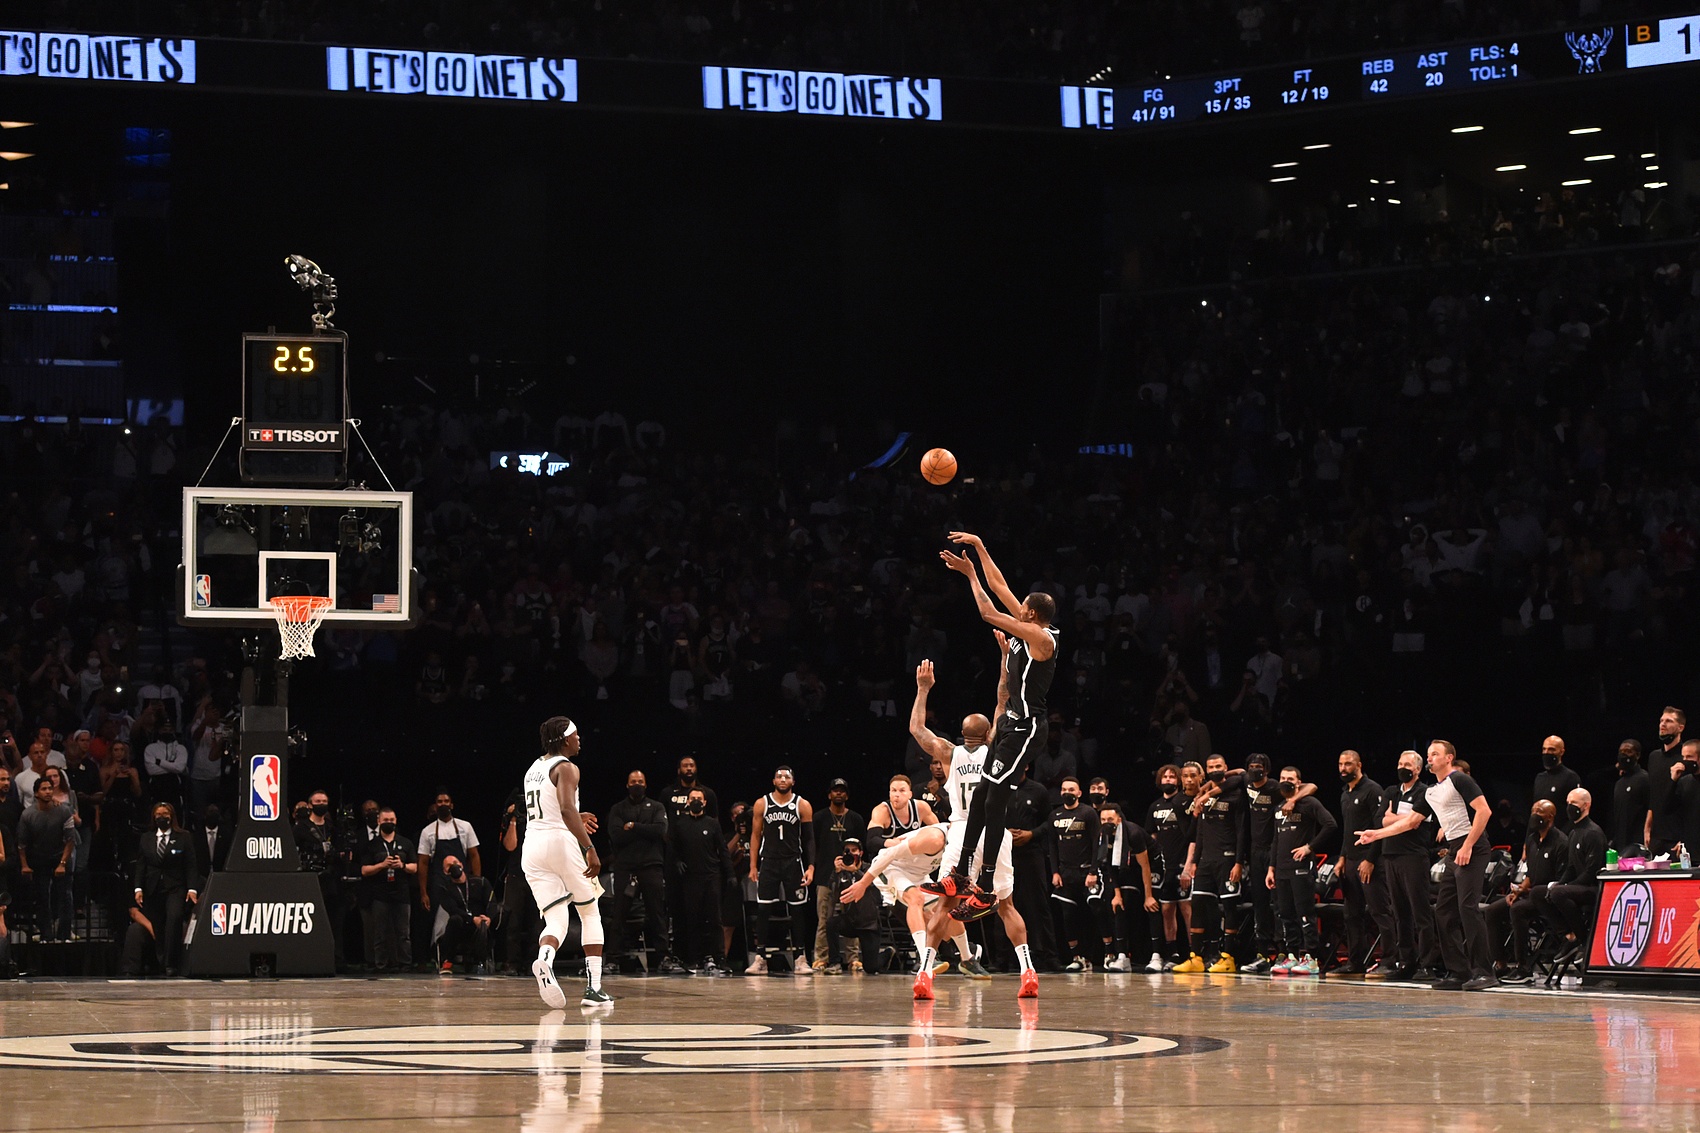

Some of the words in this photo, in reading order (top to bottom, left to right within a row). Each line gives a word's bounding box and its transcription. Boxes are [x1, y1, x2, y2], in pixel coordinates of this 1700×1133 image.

[1637, 25, 1651, 42] B
[47, 38, 80, 73] GO
[95, 38, 183, 82] NETS
[1470, 45, 1505, 61] FLS:
[1509, 42, 1519, 56] 4
[1362, 59, 1394, 75] REB
[1417, 52, 1448, 69] AST
[347, 49, 421, 91] LET'S
[435, 57, 467, 92] GO
[481, 57, 565, 100] NETS
[1293, 69, 1313, 84] FT
[1425, 71, 1444, 86] 20
[1469, 65, 1506, 81] TOL:
[1511, 63, 1518, 77] 1
[722, 68, 793, 109] LET'S
[806, 76, 837, 111] GO
[850, 78, 931, 119] NETS
[1214, 78, 1241, 94] 3PT
[1370, 78, 1388, 93] 42
[1143, 88, 1163, 103] FG
[274, 346, 314, 372] 2.5
[274, 429, 340, 443] TISSOT
[956, 763, 983, 776] TUCKE
[254, 805, 268, 816] NBA
[526, 789, 544, 822] 21
[764, 811, 799, 825] BROOKLYN
[777, 824, 784, 840] 1
[246, 837, 282, 859] @NBA
[227, 903, 314, 935] PLAYOFFS
[1657, 907, 1676, 944] VS
